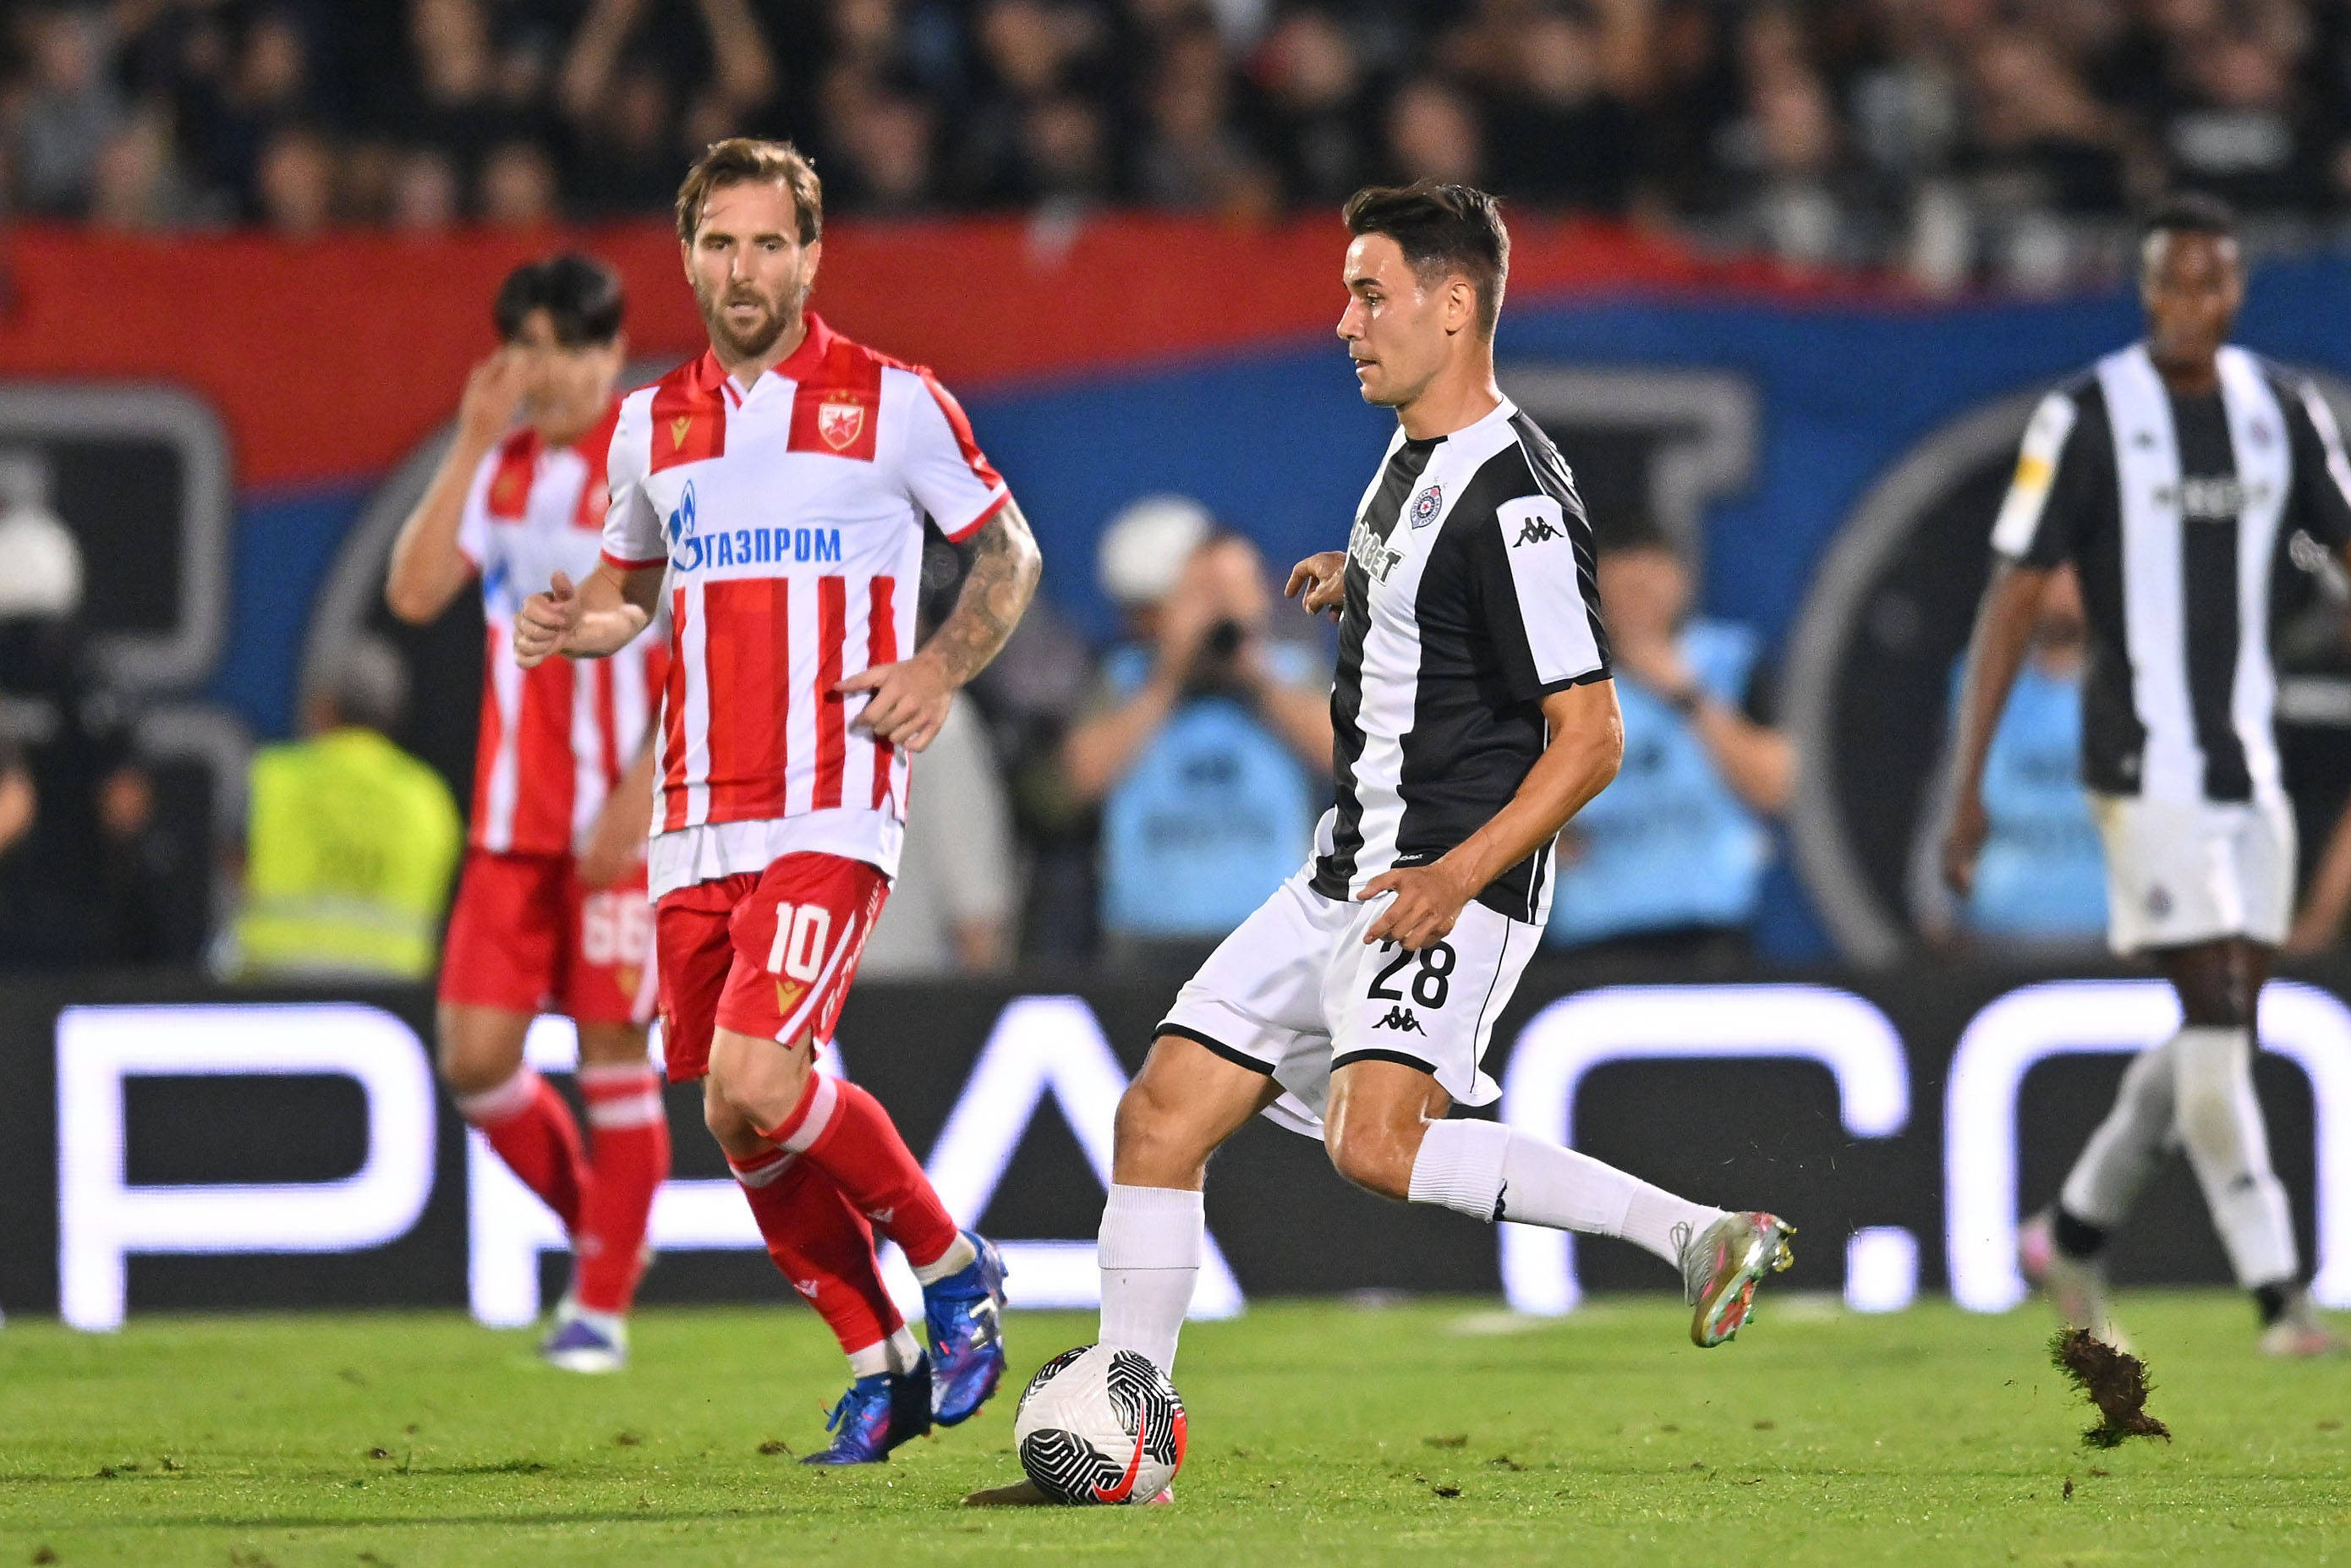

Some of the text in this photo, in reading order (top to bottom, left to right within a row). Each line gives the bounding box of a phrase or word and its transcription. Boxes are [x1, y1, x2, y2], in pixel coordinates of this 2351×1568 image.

[704, 528, 842, 568] ГАЗПРОМ
[766, 902, 830, 984] 10
[1367, 940, 1456, 1009] 28
